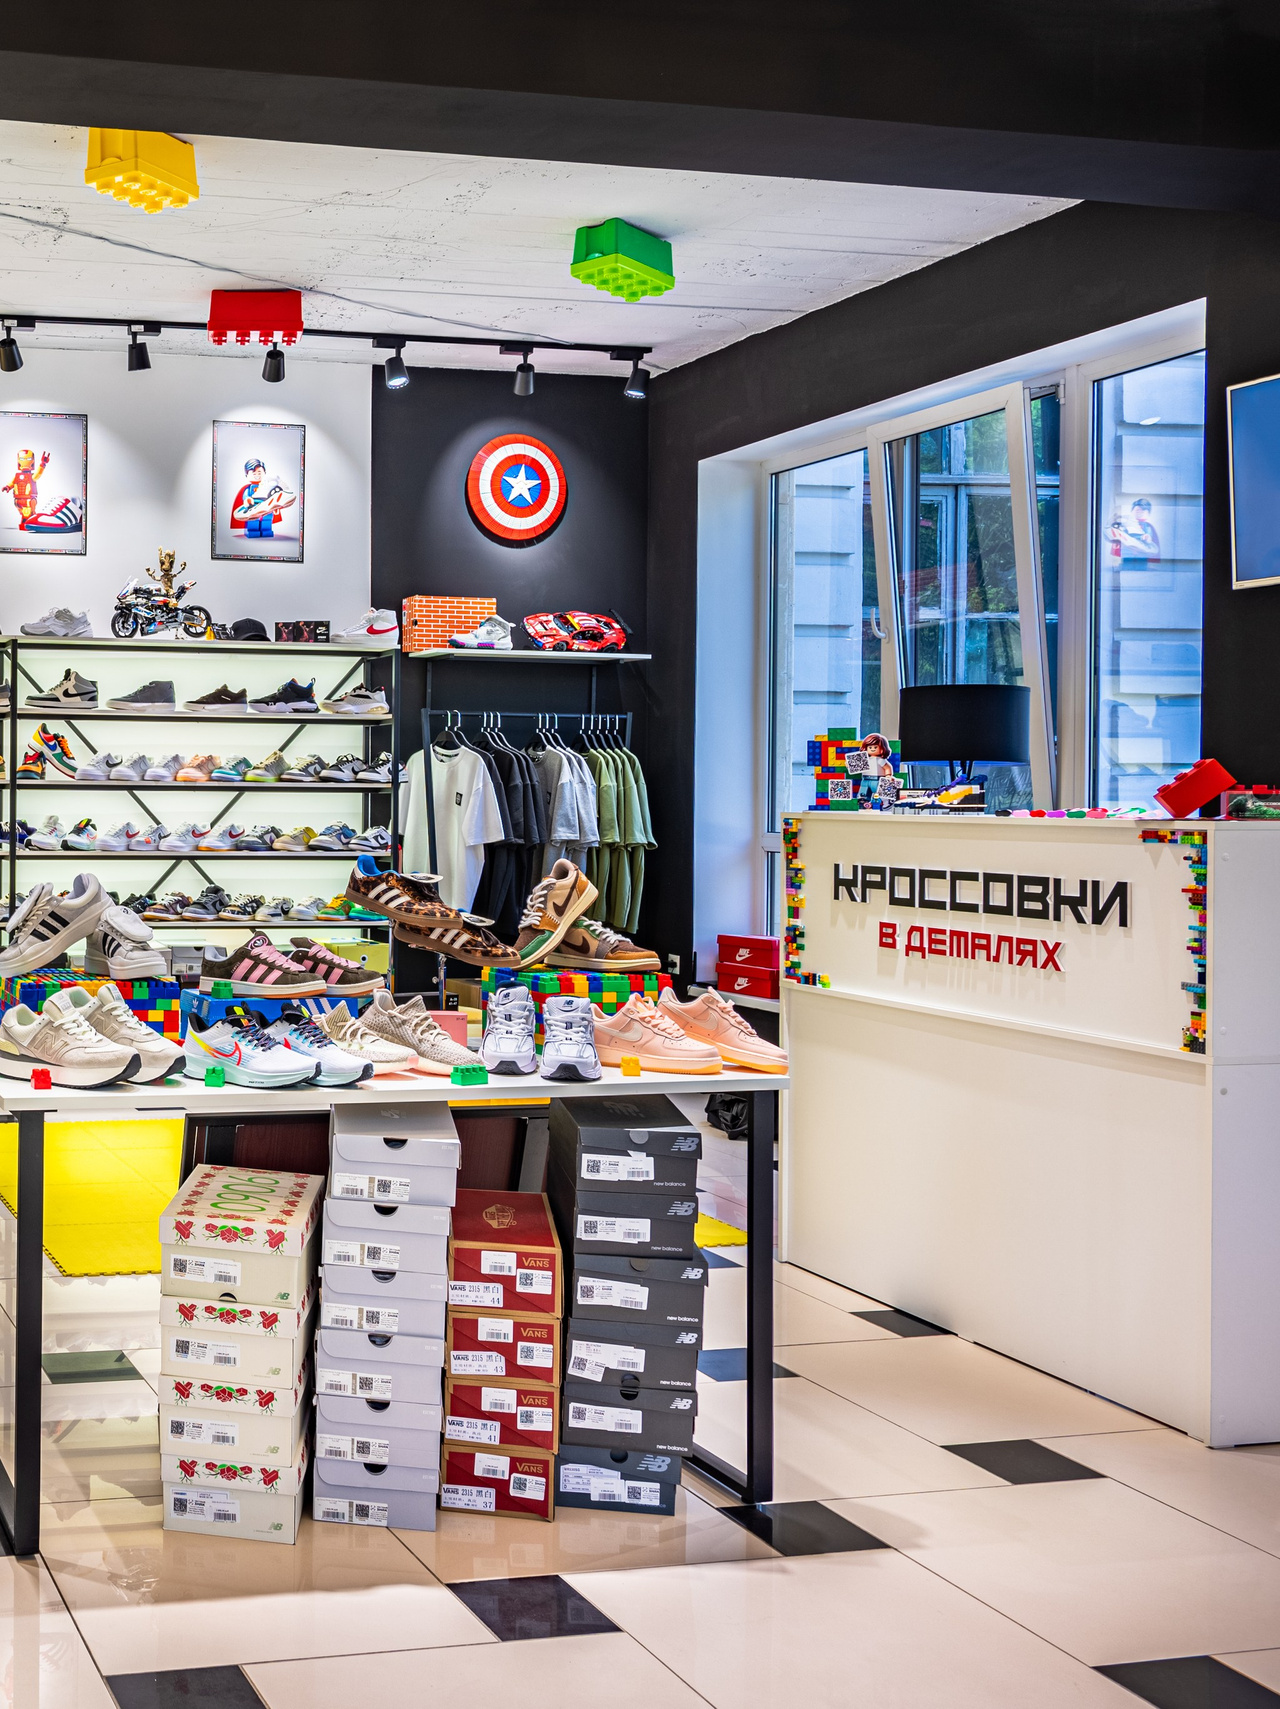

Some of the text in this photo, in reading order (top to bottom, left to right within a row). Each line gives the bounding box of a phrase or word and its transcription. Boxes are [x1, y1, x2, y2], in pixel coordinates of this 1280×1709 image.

[833, 863, 1128, 928] КРОССОВКИ
[879, 921, 1063, 972] В ДЕТАЛЯХ
[671, 1136, 700, 1152] NB
[210, 1175, 280, 1212] 9060
[667, 1201, 696, 1216] NB
[522, 1257, 550, 1268] VANS
[681, 1268, 704, 1280] NB
[450, 1284, 467, 1292] VANS
[275, 1292, 290, 1300] NB
[521, 1328, 548, 1338] VANS
[675, 1332, 698, 1344] NB
[521, 1395, 548, 1406] VANS
[670, 1398, 693, 1410] NB
[466, 1421, 478, 1429] 2315
[516, 1462, 543, 1474] VANS
[637, 1454, 672, 1472] NB
[443, 1487, 460, 1495] VANS
